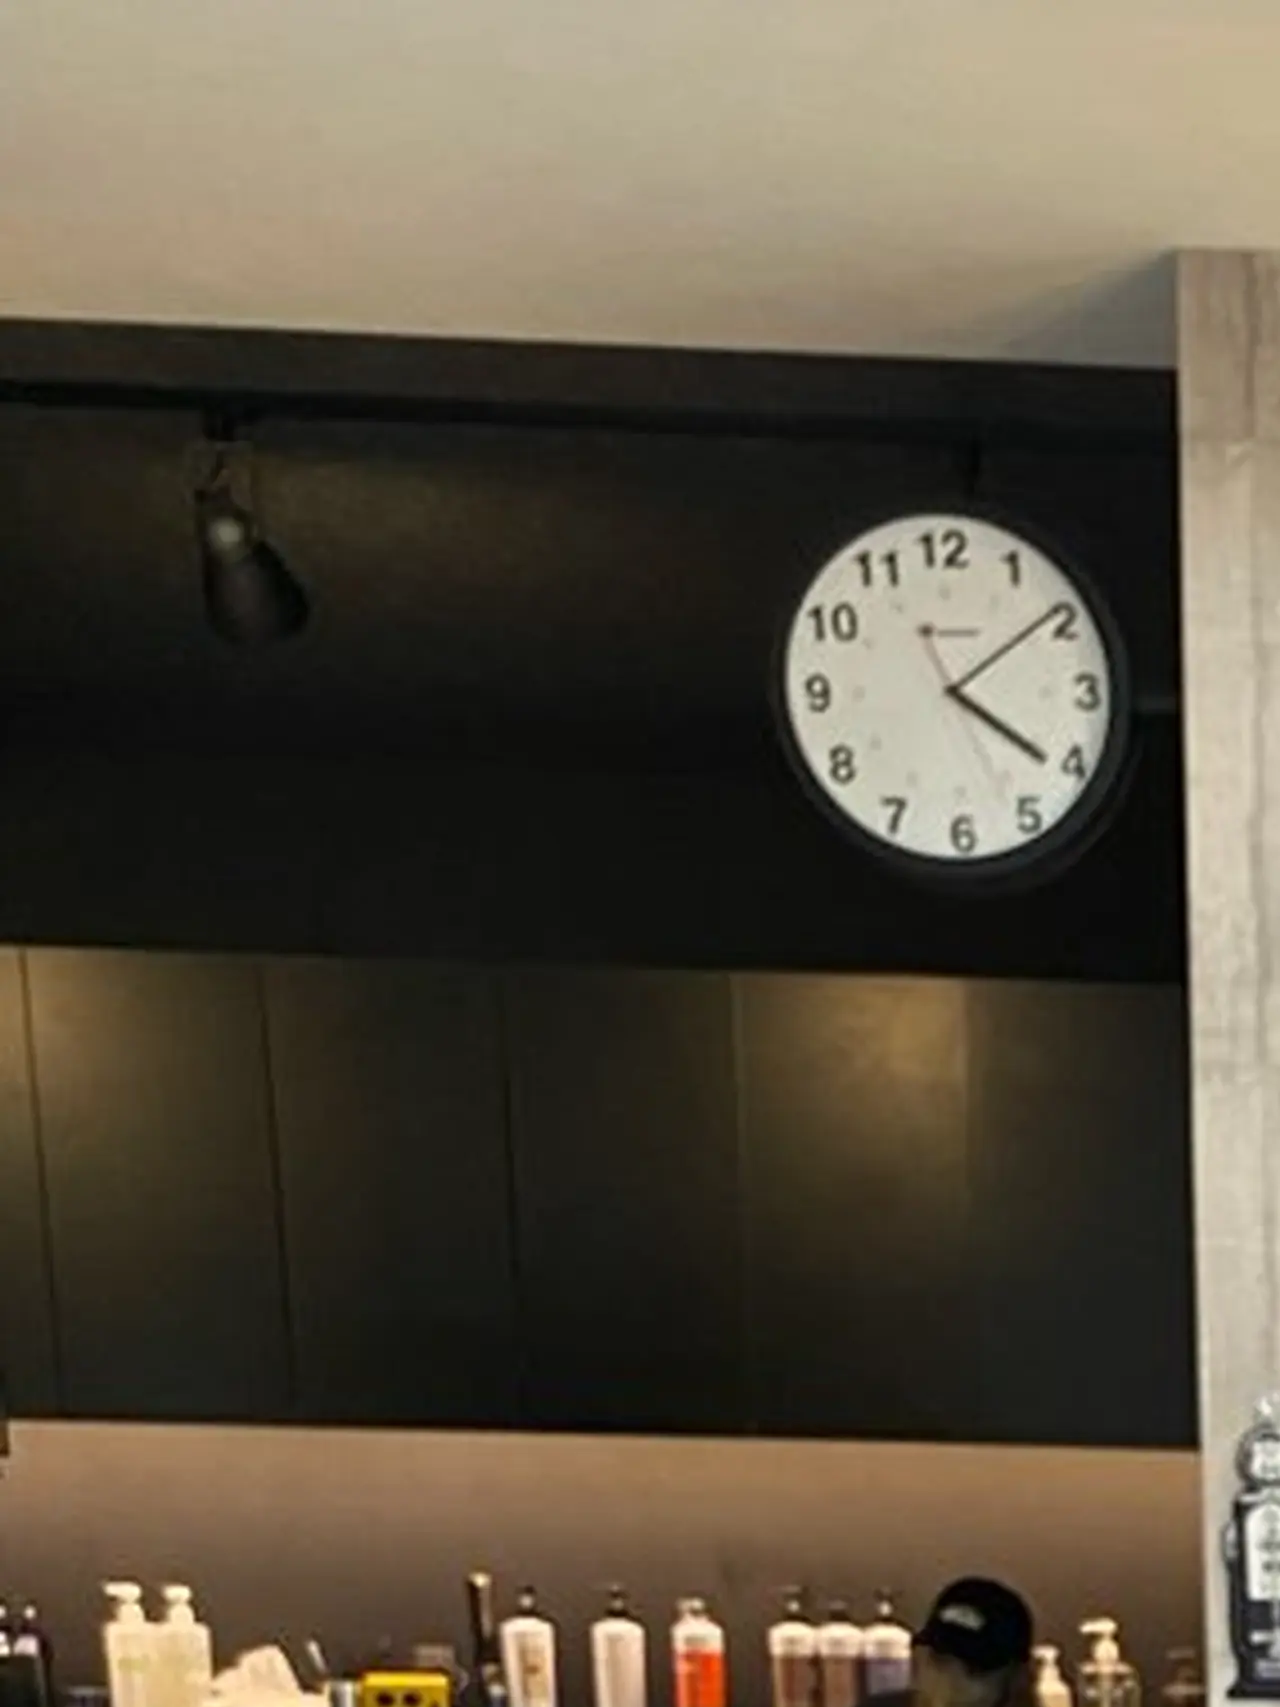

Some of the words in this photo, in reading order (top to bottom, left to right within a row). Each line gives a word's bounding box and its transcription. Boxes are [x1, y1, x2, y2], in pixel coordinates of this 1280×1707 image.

[854, 549, 899, 588] 11
[916, 529, 969, 570] 12
[1002, 550, 1022, 588] 1
[807, 602, 857, 643] 10
[1050, 602, 1078, 640] 2
[805, 673, 831, 713] 9
[1074, 674, 1102, 711] 3
[828, 745, 857, 784] 8
[1061, 745, 1086, 783] 4
[881, 797, 908, 835] 7
[949, 815, 977, 854] 6
[1016, 796, 1043, 835] 5
